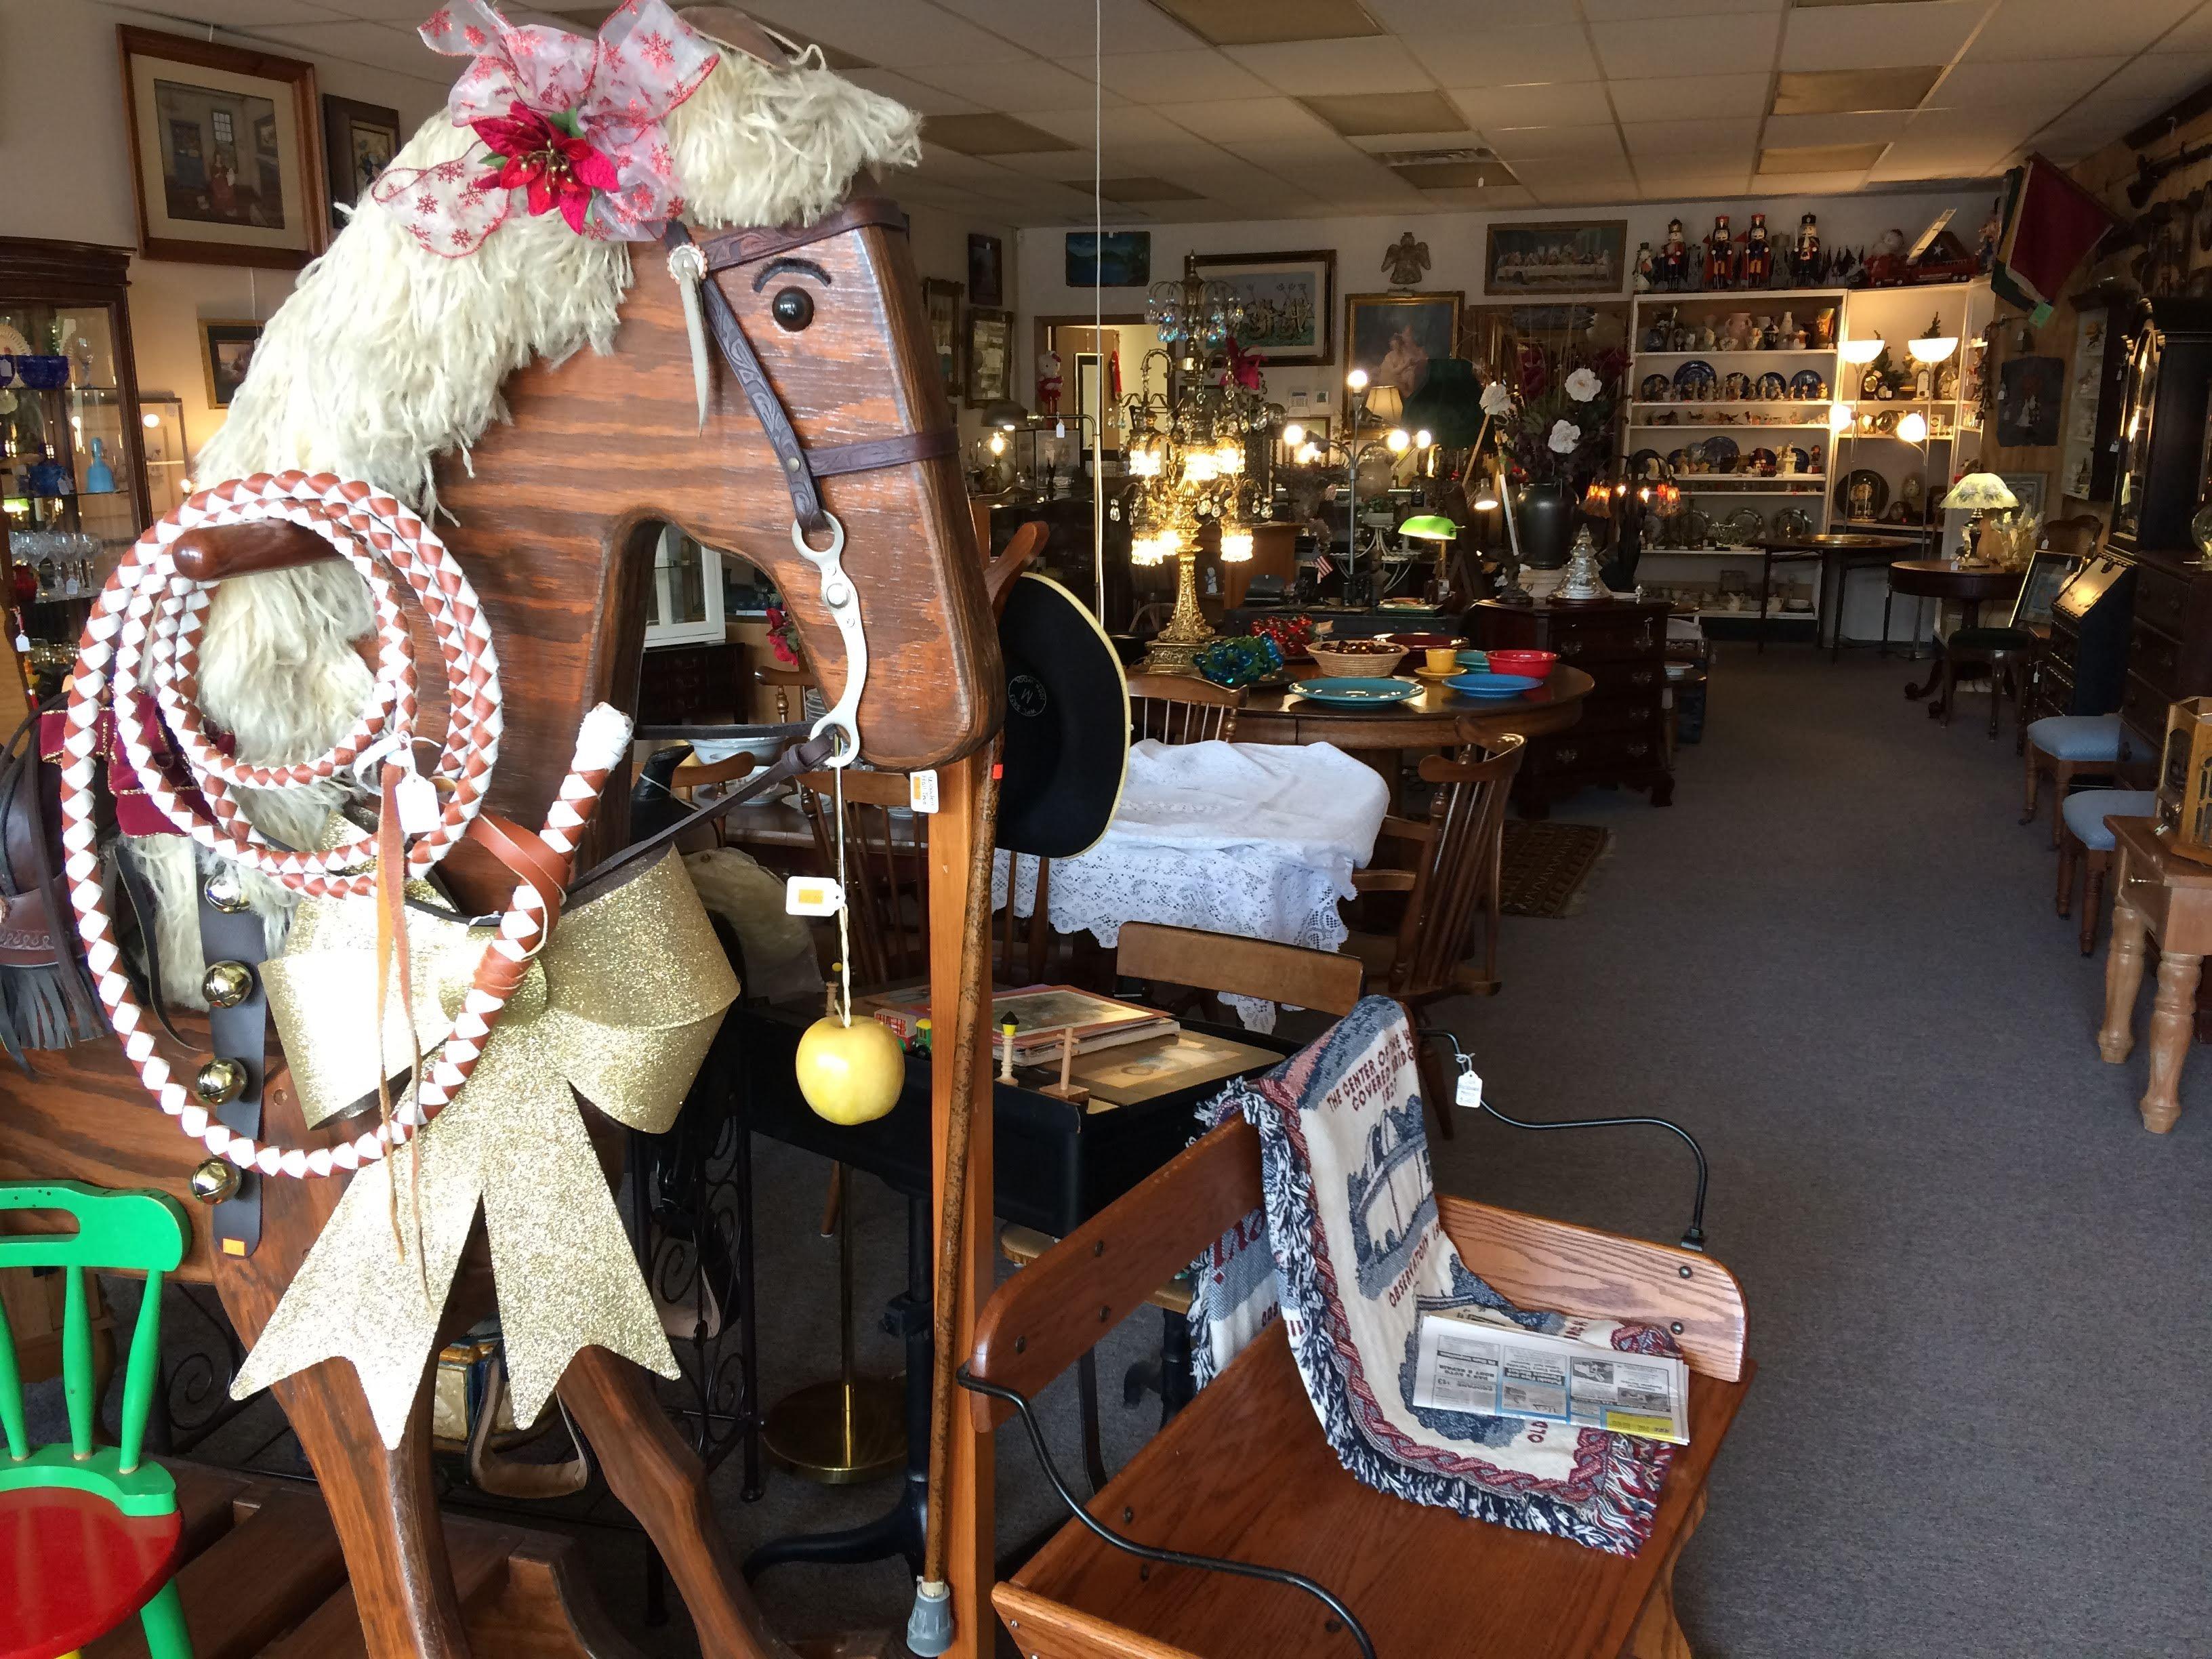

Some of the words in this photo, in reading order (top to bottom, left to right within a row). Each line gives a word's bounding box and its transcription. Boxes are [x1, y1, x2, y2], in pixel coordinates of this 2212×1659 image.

[1326, 1088, 1343, 1113] THE
[1343, 1059, 1376, 1097] CENTER
[1351, 1066, 1391, 1111] COVERED
[1527, 1420, 1549, 1443] OLD
